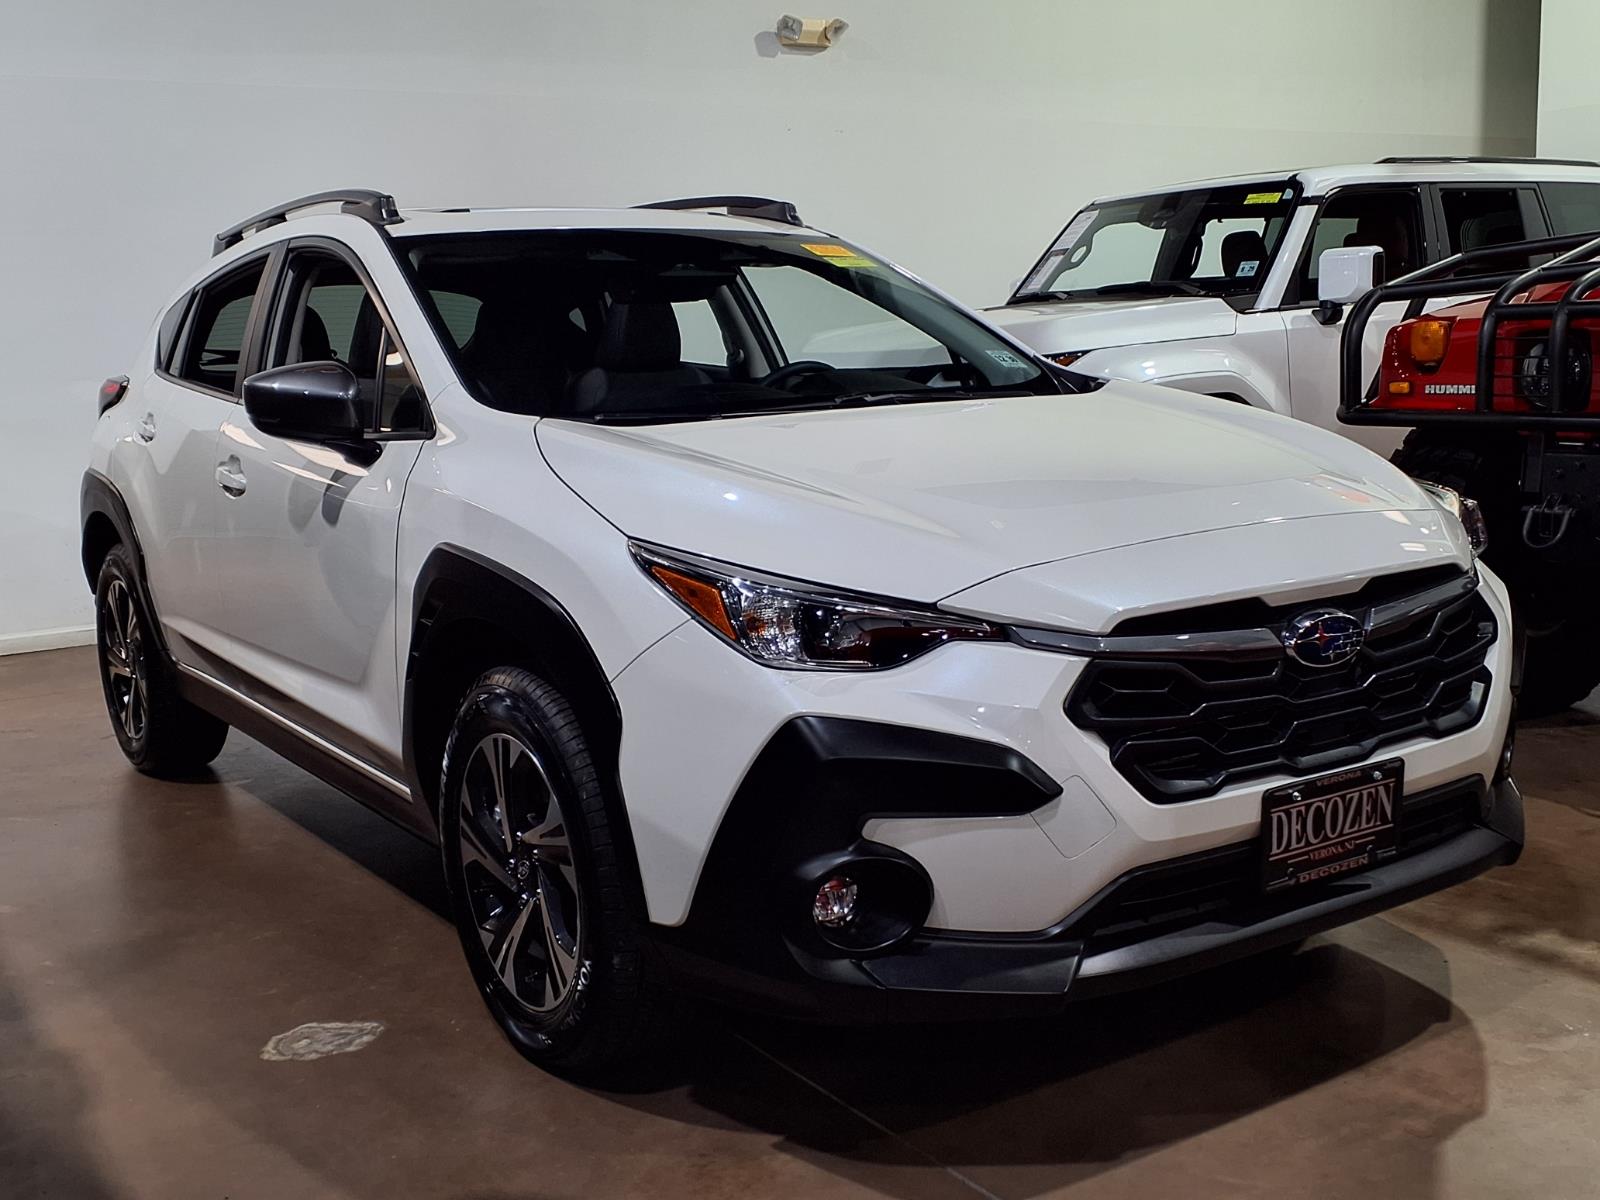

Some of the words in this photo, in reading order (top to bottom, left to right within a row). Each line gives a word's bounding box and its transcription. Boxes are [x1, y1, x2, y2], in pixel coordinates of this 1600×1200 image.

[1315, 770, 1362, 787] VERONA
[1269, 783, 1396, 855] DECOZEN
[1299, 857, 1369, 883] DECOZEN
